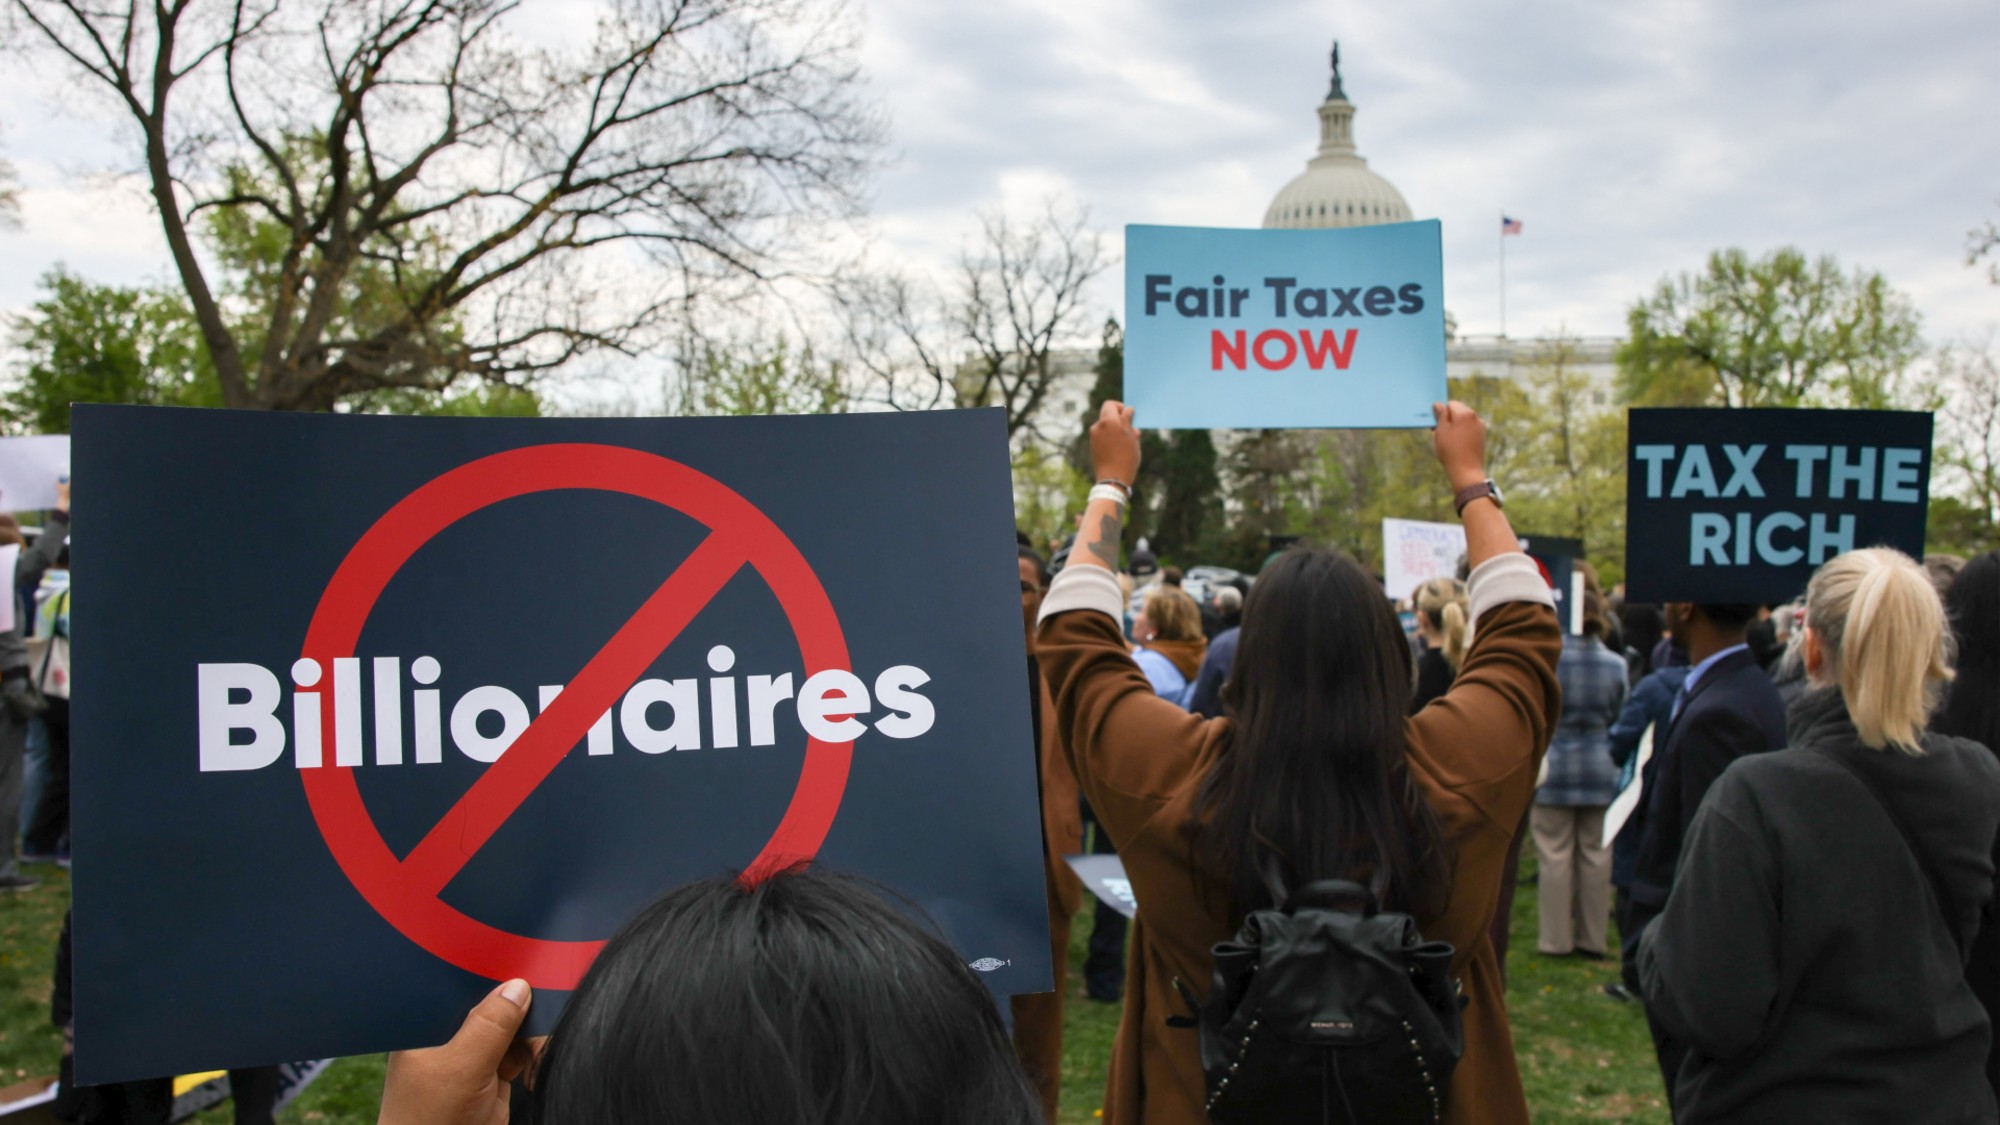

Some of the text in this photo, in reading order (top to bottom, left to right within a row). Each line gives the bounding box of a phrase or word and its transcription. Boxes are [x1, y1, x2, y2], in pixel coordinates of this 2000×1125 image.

[1145, 274, 1425, 318] Fair Taxes
[1211, 329, 1358, 371] NOW
[1636, 444, 1922, 503] TAX THE
[1690, 511, 1856, 566] RICH
